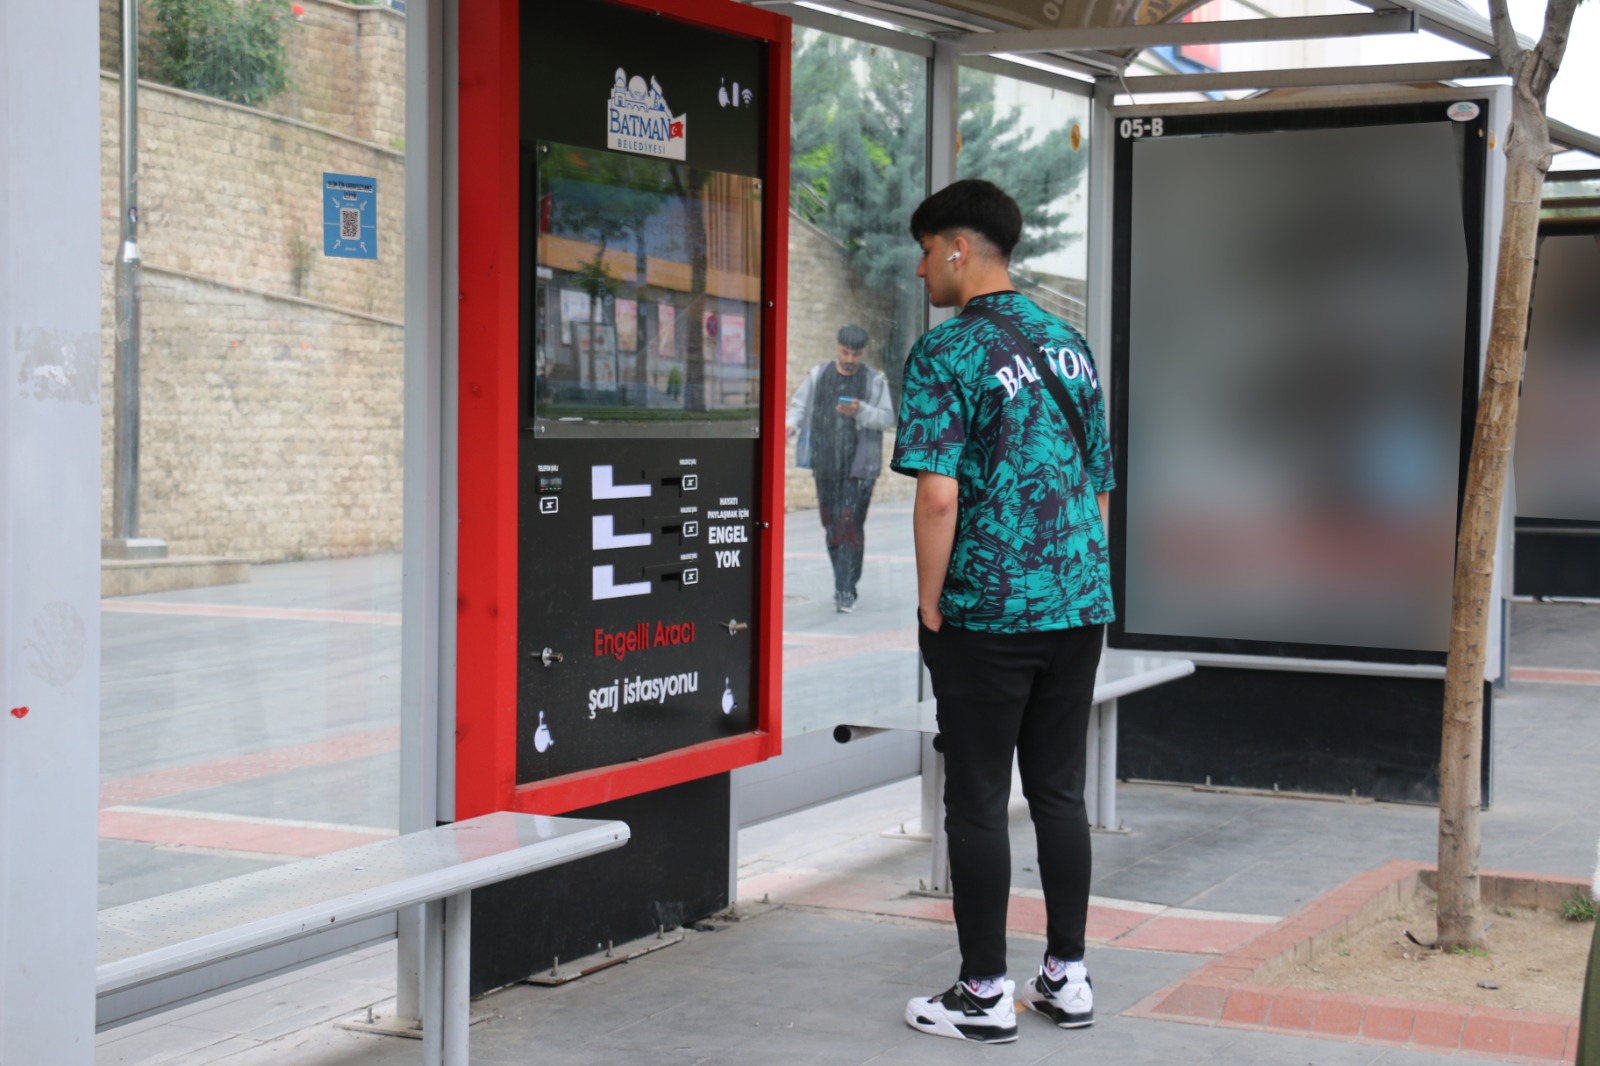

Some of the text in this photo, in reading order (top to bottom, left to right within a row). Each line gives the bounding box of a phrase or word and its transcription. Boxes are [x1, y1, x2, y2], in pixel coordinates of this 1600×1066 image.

[609, 108, 671, 142] BATMAN
[1120, 118, 1163, 139] 05-B
[617, 139, 666, 155] BELEDİYESİ
[708, 525, 748, 544] ENGEL
[715, 550, 741, 568] YOK
[593, 620, 695, 661] Engelli Aracı
[588, 671, 698, 719] şarj istasyonu
